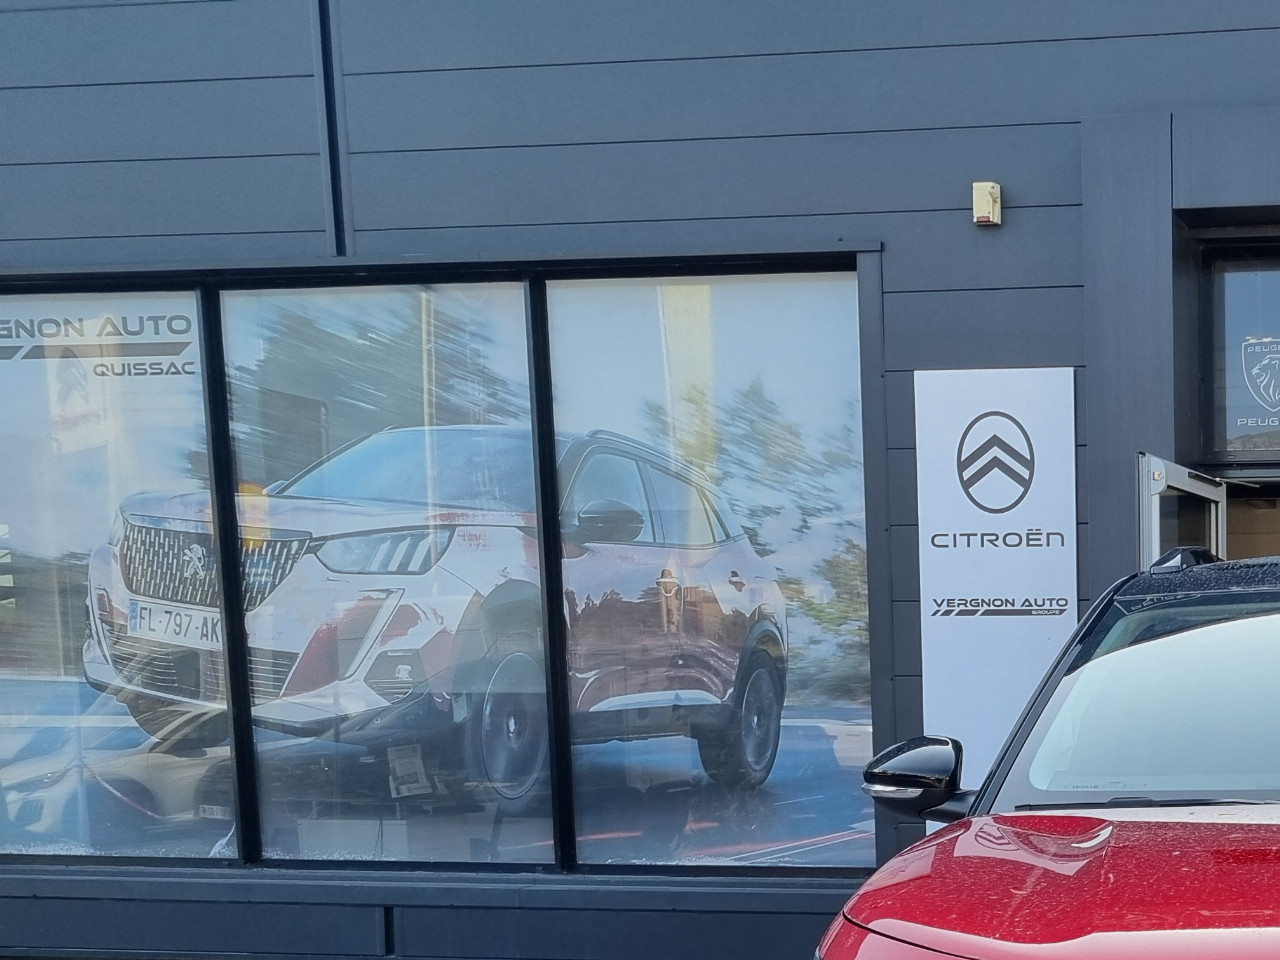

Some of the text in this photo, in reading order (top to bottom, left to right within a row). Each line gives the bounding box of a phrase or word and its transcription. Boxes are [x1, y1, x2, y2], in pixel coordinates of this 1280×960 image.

[96, 314, 192, 337] AUTO
[93, 361, 196, 377] QUISSAC
[932, 597, 1069, 609] VERGNON AUTO
